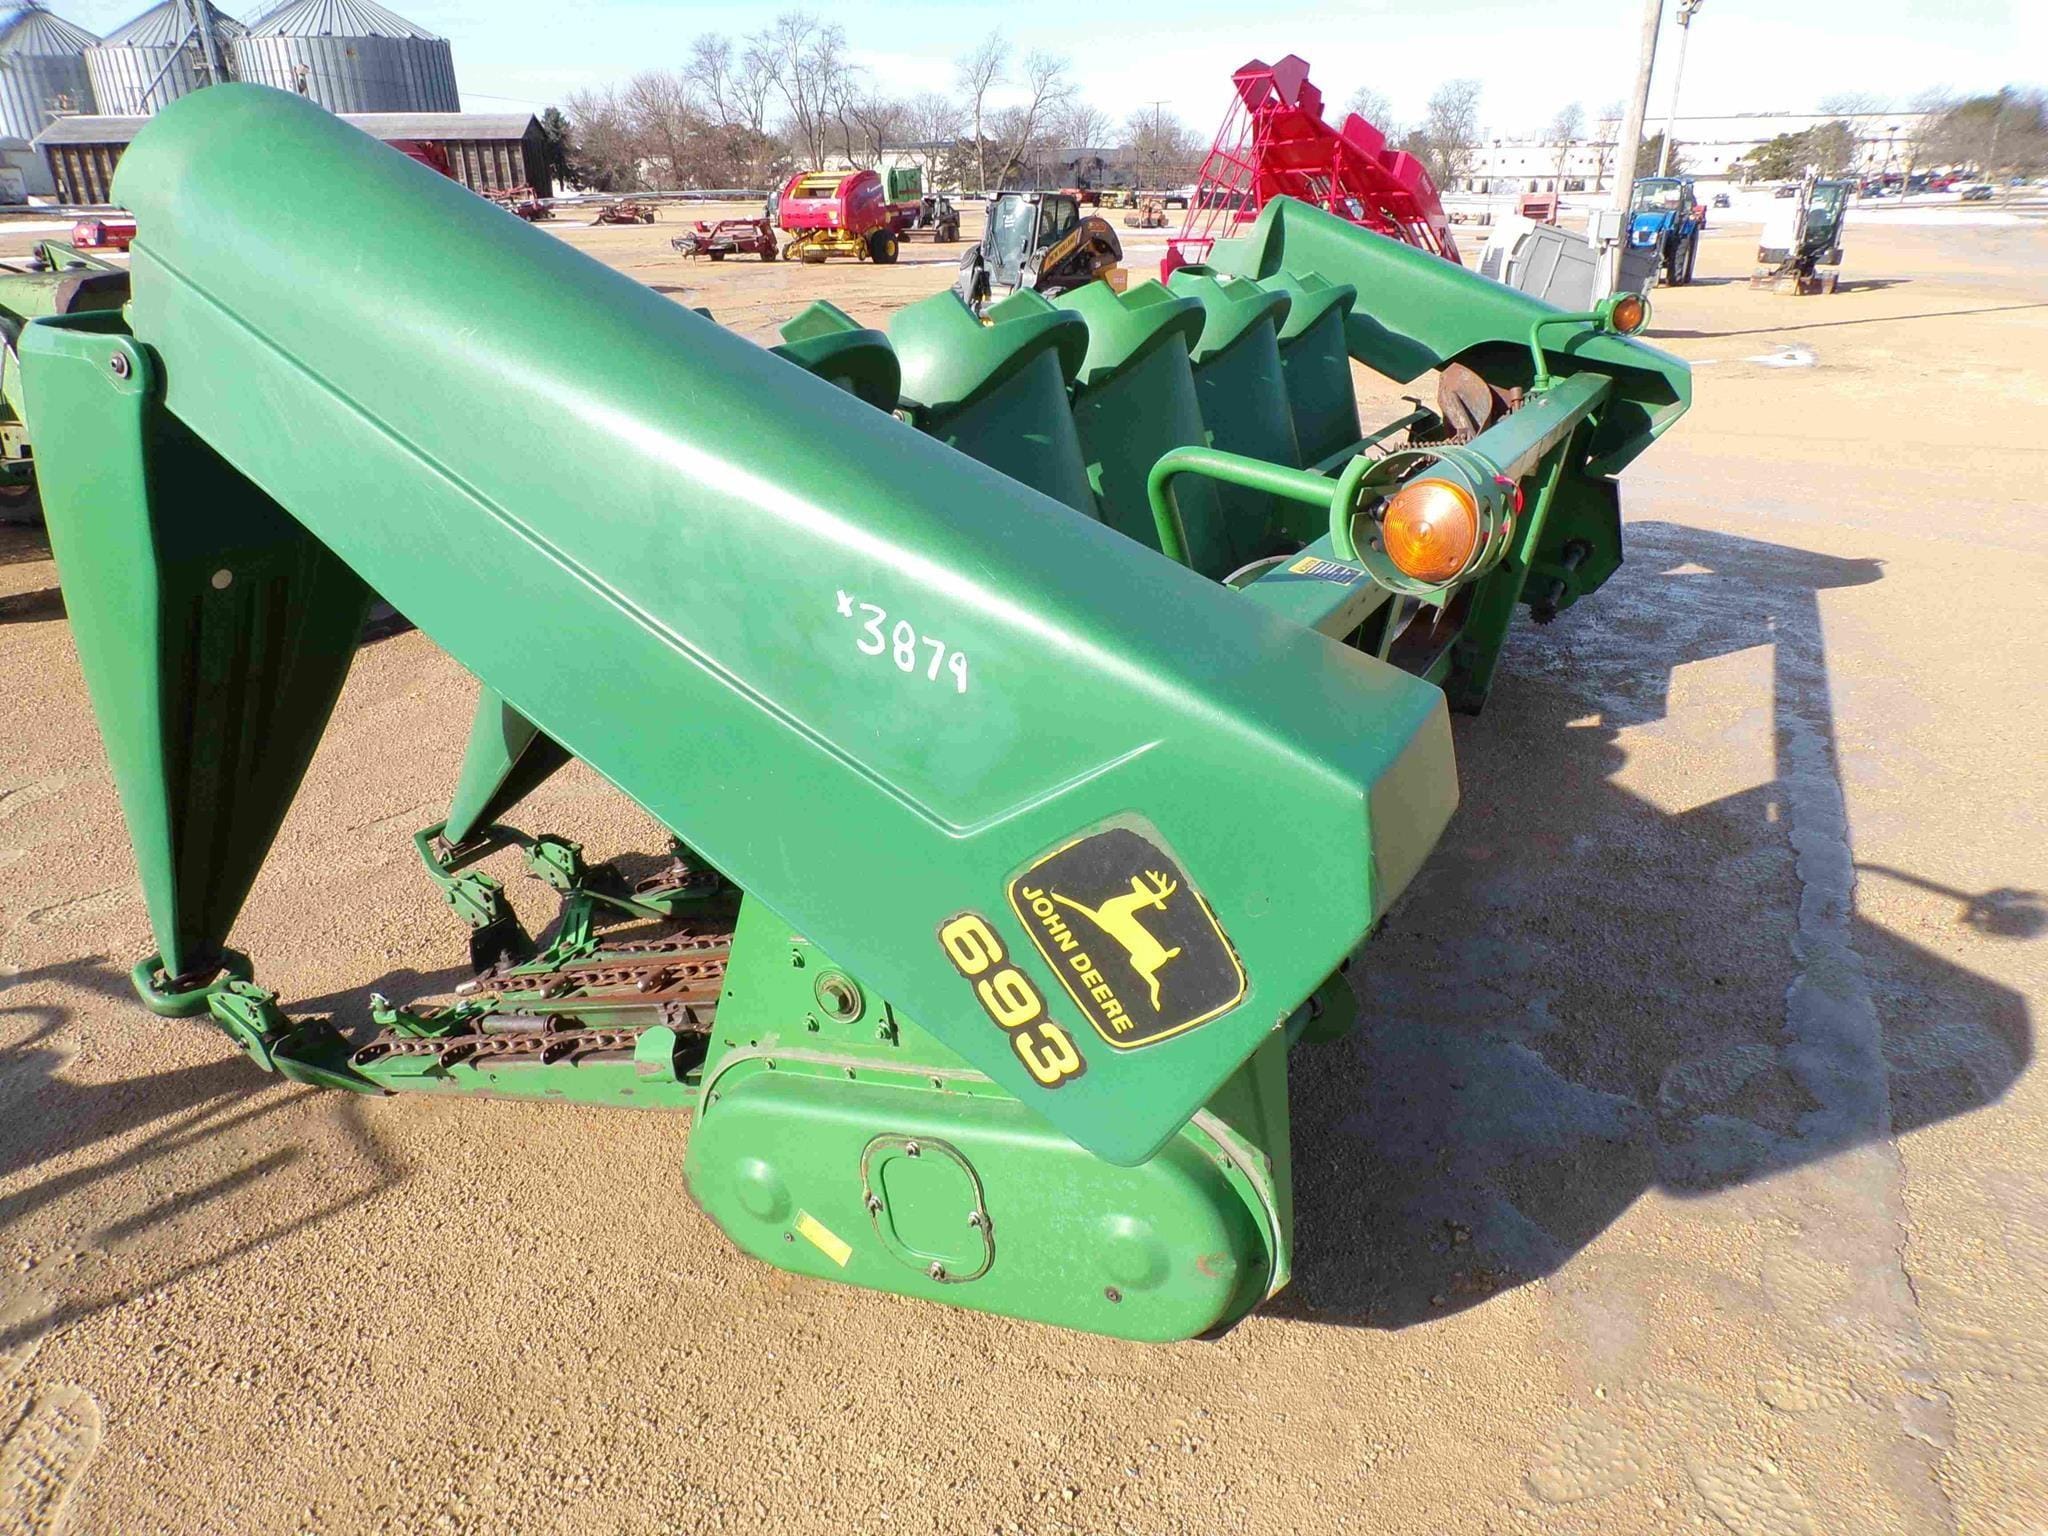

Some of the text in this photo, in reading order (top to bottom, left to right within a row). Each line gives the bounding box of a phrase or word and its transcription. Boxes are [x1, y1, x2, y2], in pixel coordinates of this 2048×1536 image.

[941, 915, 1080, 1083] 693
[1022, 886, 1134, 1034] JOHN DEERE
